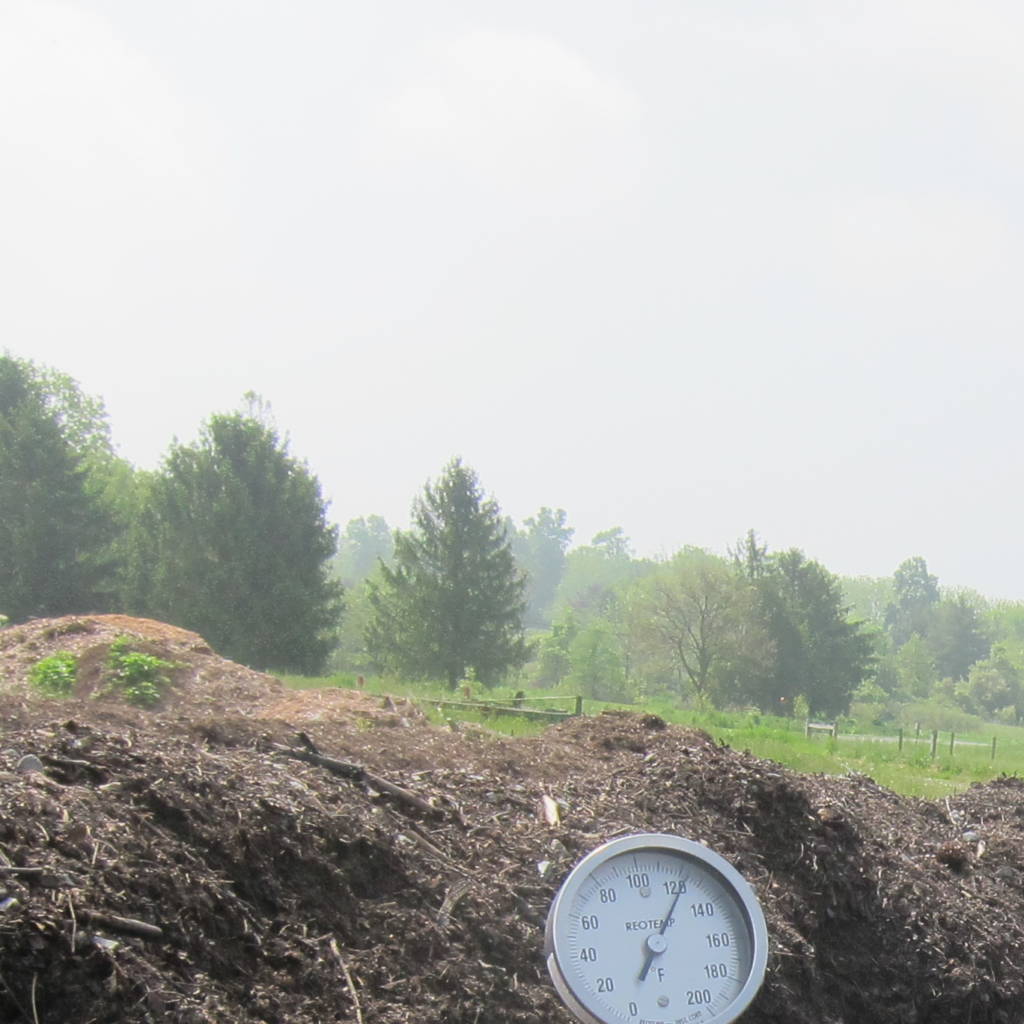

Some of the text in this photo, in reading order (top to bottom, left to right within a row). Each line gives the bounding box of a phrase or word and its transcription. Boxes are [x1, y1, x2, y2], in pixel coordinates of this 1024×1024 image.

[626, 873, 649, 888] 100
[664, 880, 686, 895] 120
[600, 888, 616, 903] 80
[691, 903, 714, 918] 140
[582, 915, 598, 930] 60
[707, 933, 729, 948] 160
[580, 947, 597, 962] 40
[704, 963, 727, 979] 180
[597, 977, 614, 993] 20
[686, 989, 711, 1005] 200
[629, 1002, 638, 1017] 0
